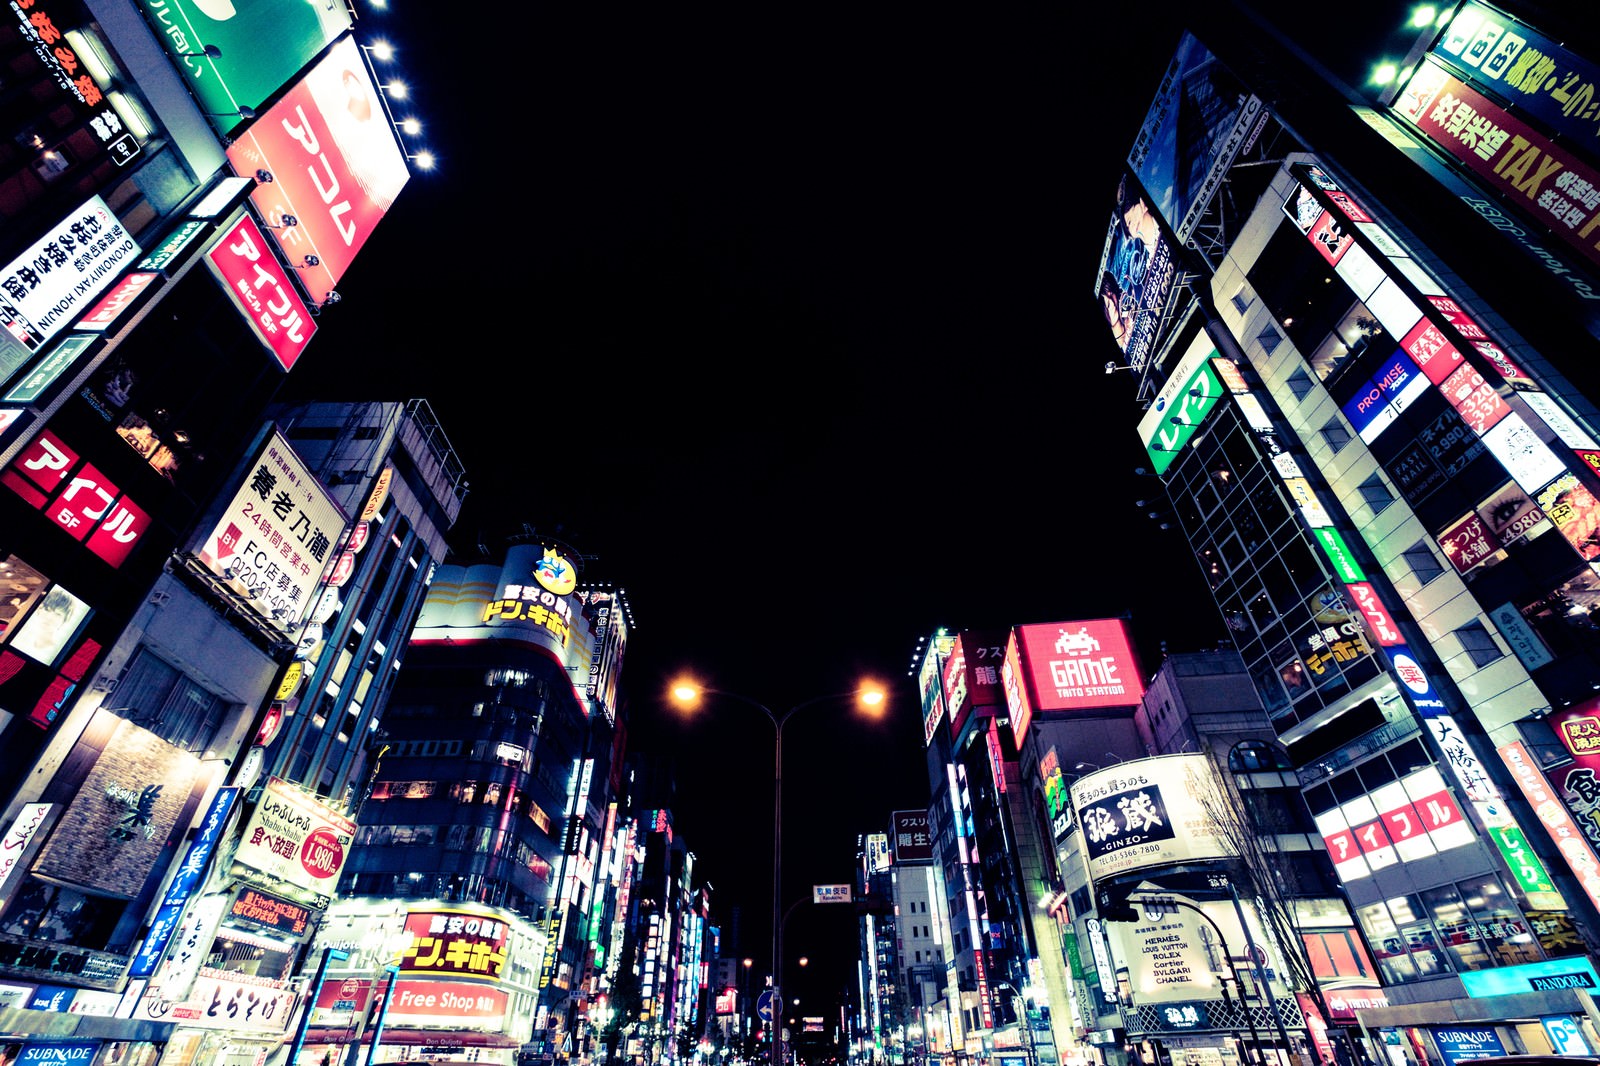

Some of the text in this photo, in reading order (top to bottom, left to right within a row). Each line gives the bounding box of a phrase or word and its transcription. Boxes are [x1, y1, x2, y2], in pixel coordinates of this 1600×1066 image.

[1471, 31, 1496, 58] B1
[1489, 41, 1518, 71] B2
[1429, 93, 1511, 161] 欢迎光临
[116, 142, 131, 157] 8F
[281, 105, 356, 247] アコム
[1493, 134, 1564, 200] TAX
[1537, 190, 1587, 229] 供应店
[1, 215, 102, 302] お好み焼き本陣
[75, 239, 134, 297] OKONOMIYAKI
[1528, 244, 1571, 274] Your
[229, 228, 304, 343] アイフル
[37, 292, 76, 331] HONJIN
[1410, 326, 1436, 355] FAS
[1419, 336, 1447, 364] NAI
[1159, 370, 1210, 453] レイク
[24, 438, 138, 543] アイフル
[57, 508, 81, 529] 5F
[221, 533, 237, 550] B1
[242, 502, 310, 576] 24時間営業中
[1442, 517, 1483, 555] まつげ
[1461, 535, 1491, 566] 本舗
[243, 540, 303, 605] FC店募集
[1352, 586, 1398, 642] アイフル
[1049, 656, 1122, 688] GAME
[1056, 684, 1126, 699] TAITO STATION
[1438, 720, 1492, 794] 大勝軒
[900, 817, 931, 827] クスリ
[1332, 800, 1450, 859] アイフル
[250, 827, 300, 860] 食べ放題!
[898, 832, 931, 847] 龍生
[304, 843, 333, 873] 1,980
[1501, 831, 1537, 884] レイク
[1152, 951, 1181, 960] ROLEX
[1161, 942, 1188, 952] VUITTON
[1153, 967, 1191, 976] BVLGARI
[1154, 960, 1184, 969] Cartier
[1156, 975, 1192, 985] CHANEL
[1534, 972, 1588, 991] PANDORA
[207, 985, 283, 1021] とらそば
[399, 991, 436, 1008] Free
[439, 991, 474, 1012] Shop
[426, 1038, 463, 1047] Don Quijote
[1438, 1031, 1495, 1045] SUBNADE
[1551, 1025, 1569, 1048] P
[24, 1047, 92, 1061] SUBNADE
